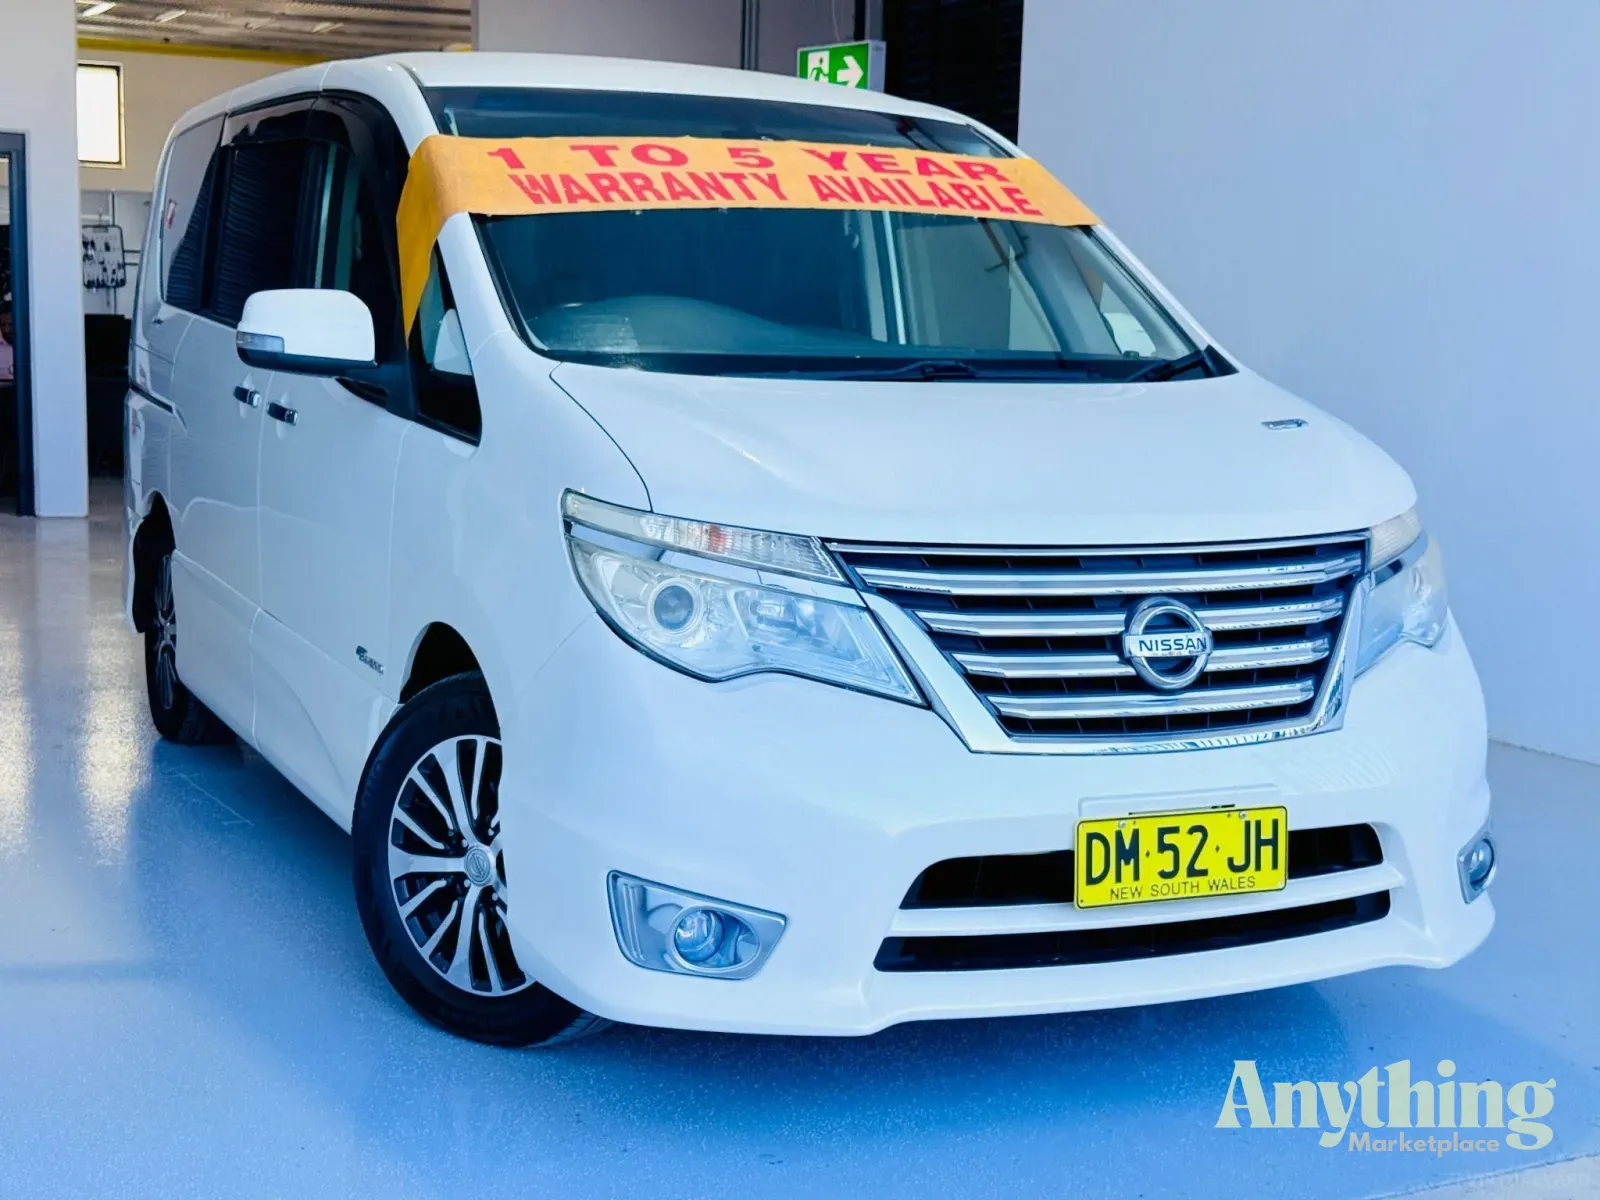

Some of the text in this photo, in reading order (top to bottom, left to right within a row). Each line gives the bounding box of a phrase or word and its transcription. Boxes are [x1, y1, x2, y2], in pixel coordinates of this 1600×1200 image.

[488, 143, 1012, 183] 1 TO 5 YEAR
[507, 171, 1044, 217] WARRANTY AVAILABLE
[1138, 637, 1207, 652] NISSAN
[1156, 824, 1209, 880] 52
[1226, 818, 1279, 874] JH
[1110, 876, 1256, 901] NEW SOUTH WALES
